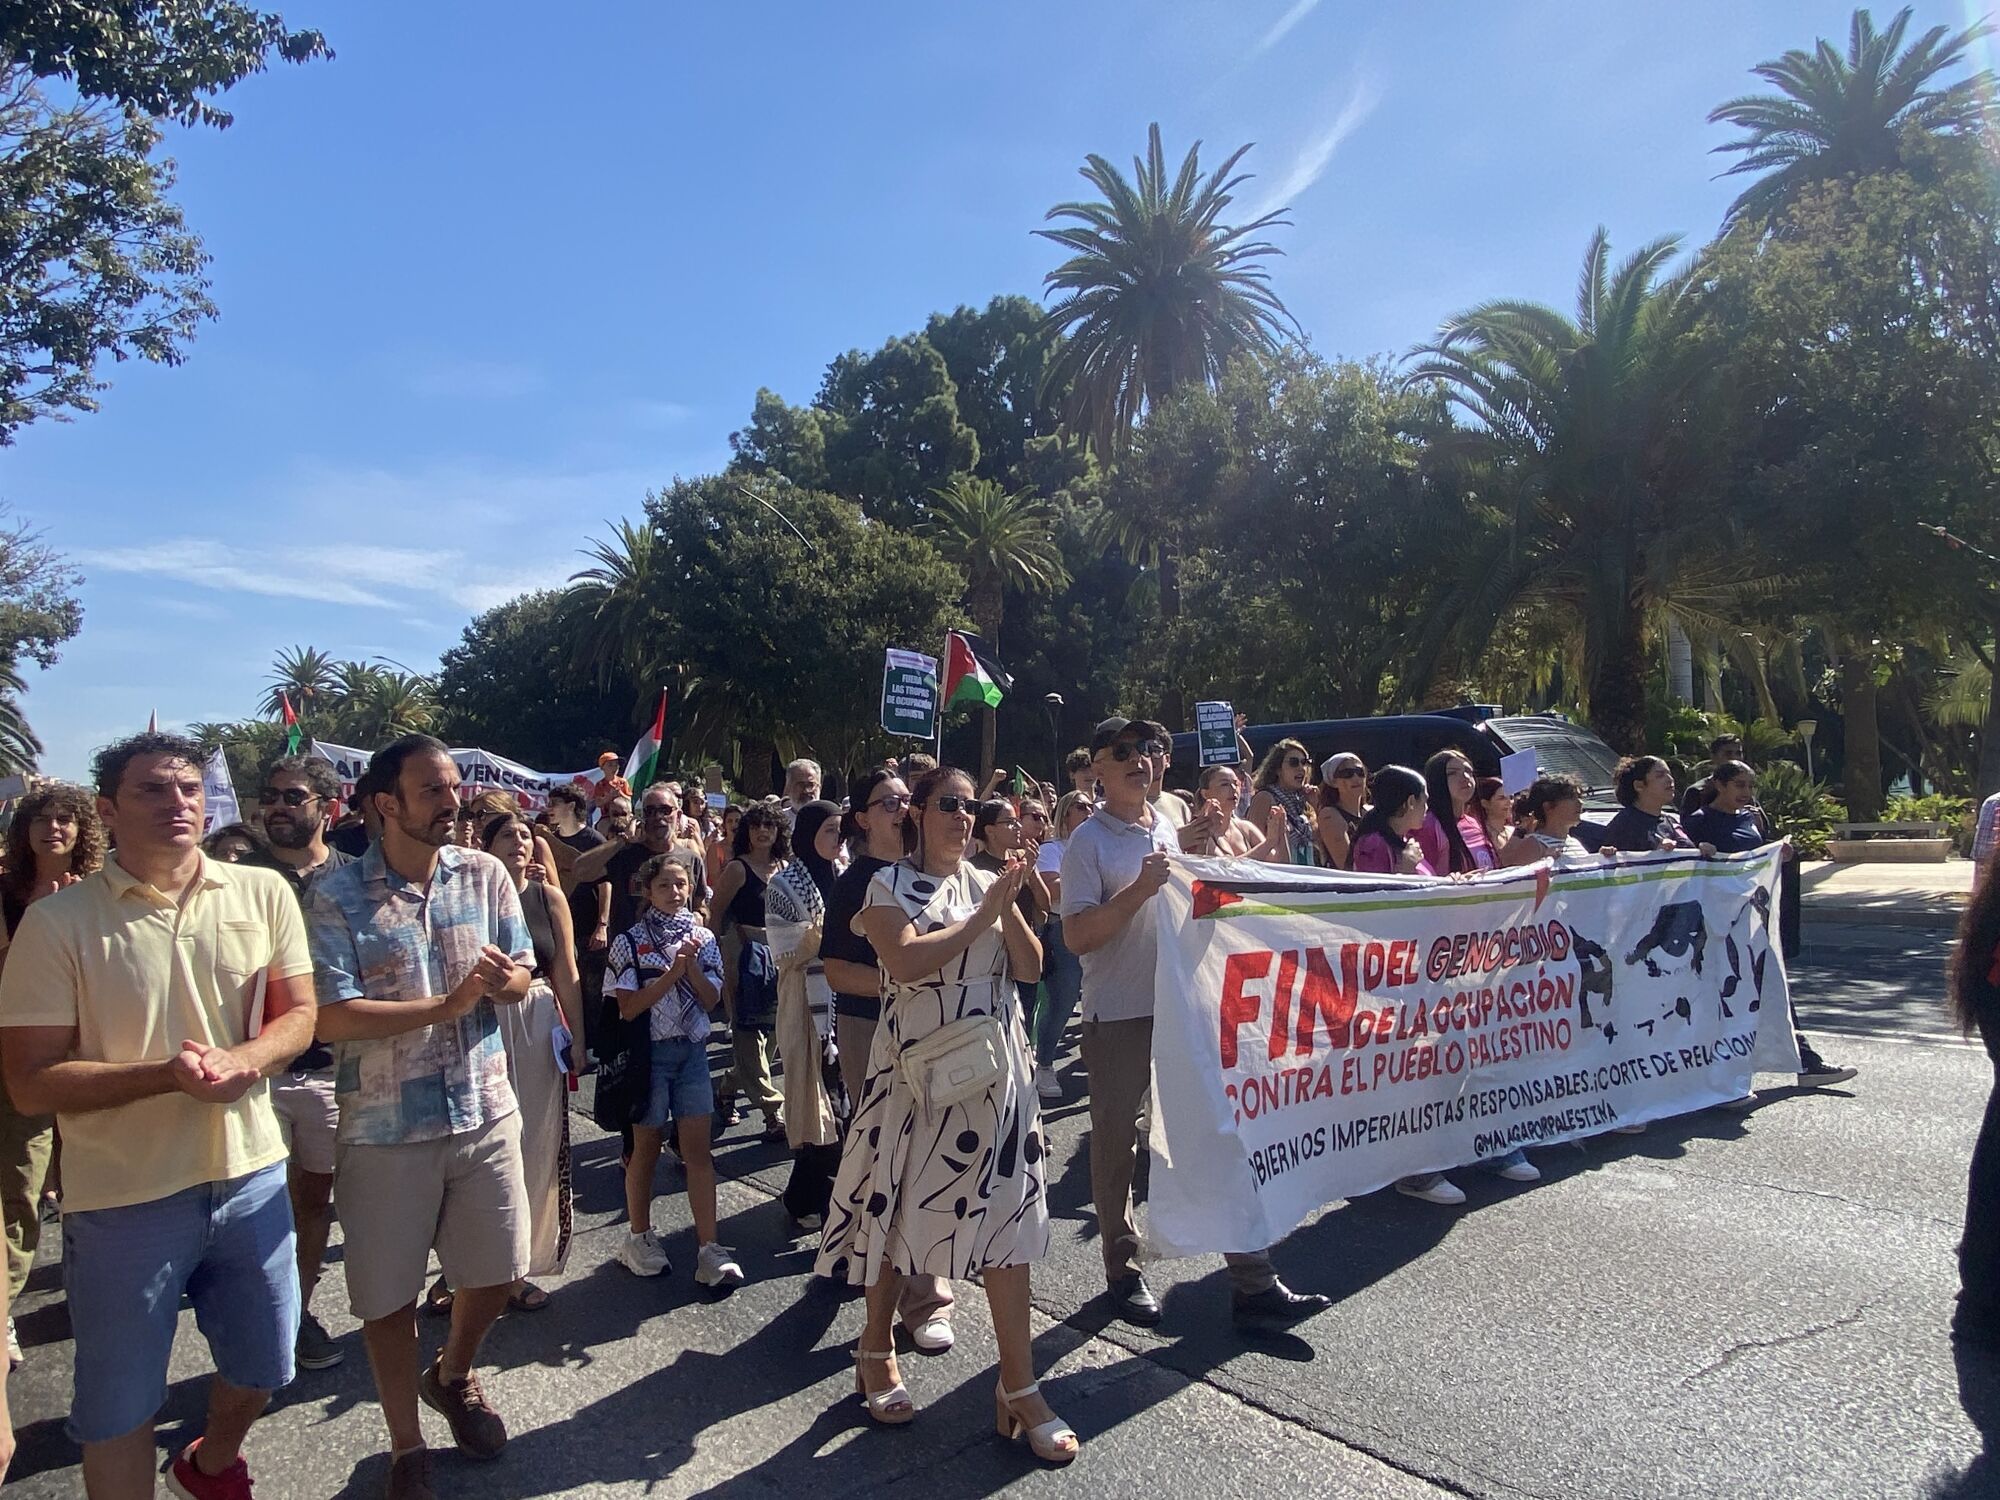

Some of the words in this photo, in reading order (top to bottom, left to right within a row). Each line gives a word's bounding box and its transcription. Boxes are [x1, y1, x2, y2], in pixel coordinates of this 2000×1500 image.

[886, 695, 895, 704] DE
[892, 684, 904, 694] LAS
[905, 685, 930, 698] TROPAS
[902, 674, 922, 685] FUERA
[1364, 939, 1419, 991] DEL
[1426, 919, 1570, 982] GENOCIDIO
[1220, 943, 1360, 1069] FIN
[1353, 1006, 1395, 1050] DE
[1396, 998, 1428, 1040] LA
[1433, 965, 1574, 1034] OCUPACIÓN
[1340, 1056, 1368, 1096] EL
[1373, 1040, 1464, 1091] PUEBLO
[1468, 1018, 1571, 1069] PALESTINO
[1332, 1093, 1465, 1152] IMPERIALISTAS
[1650, 1051, 1678, 1077] DE
